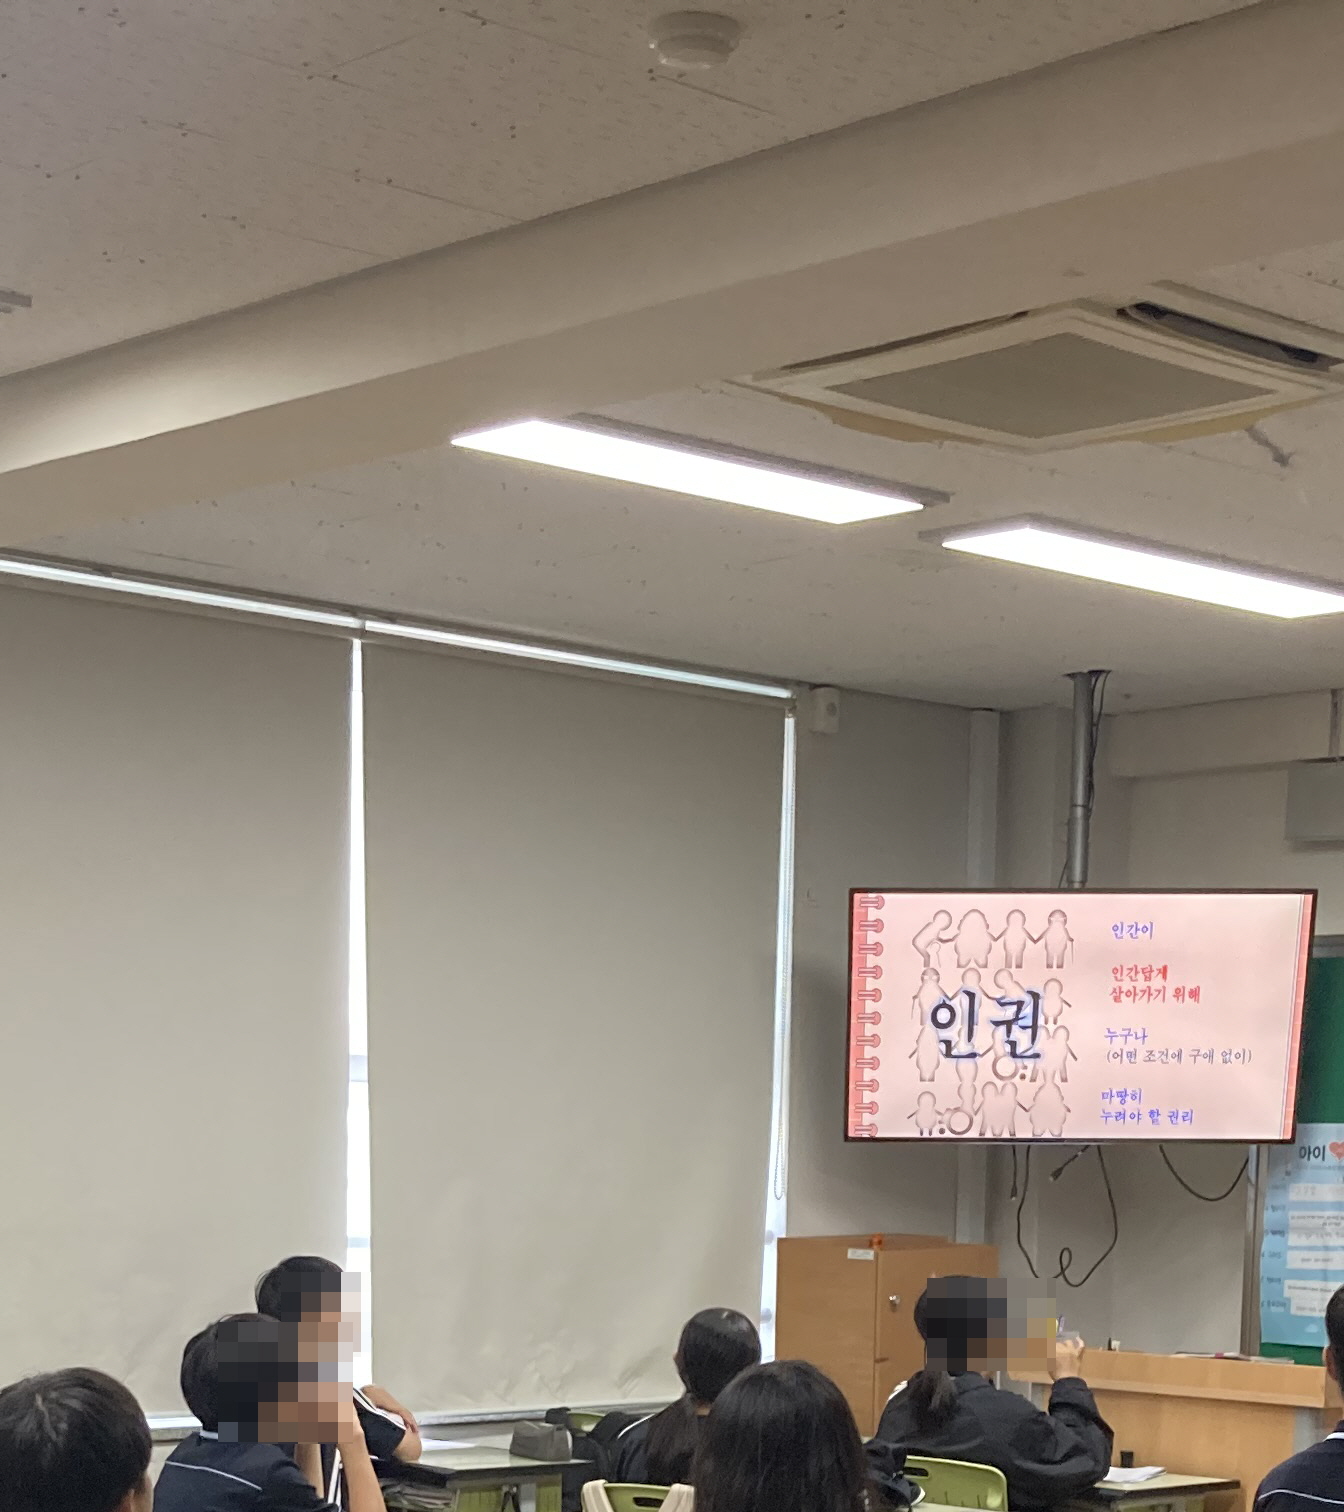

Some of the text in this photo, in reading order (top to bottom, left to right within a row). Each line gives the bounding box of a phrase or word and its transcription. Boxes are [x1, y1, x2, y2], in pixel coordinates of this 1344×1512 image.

[1111, 921, 1154, 940] 인간이
[1111, 964, 1169, 982] 인간답게
[1109, 985, 1201, 1004] 살아가기 위해
[930, 988, 1042, 1059] 인권
[1104, 1027, 1148, 1045] 누구나
[1106, 1048, 1253, 1065] (어떤 조건에 구애 없이)
[1101, 1087, 1143, 1105] 마땅히
[1100, 1108, 1194, 1125] 누려야 할 권리
[1298, 1145, 1326, 1162] 아이
